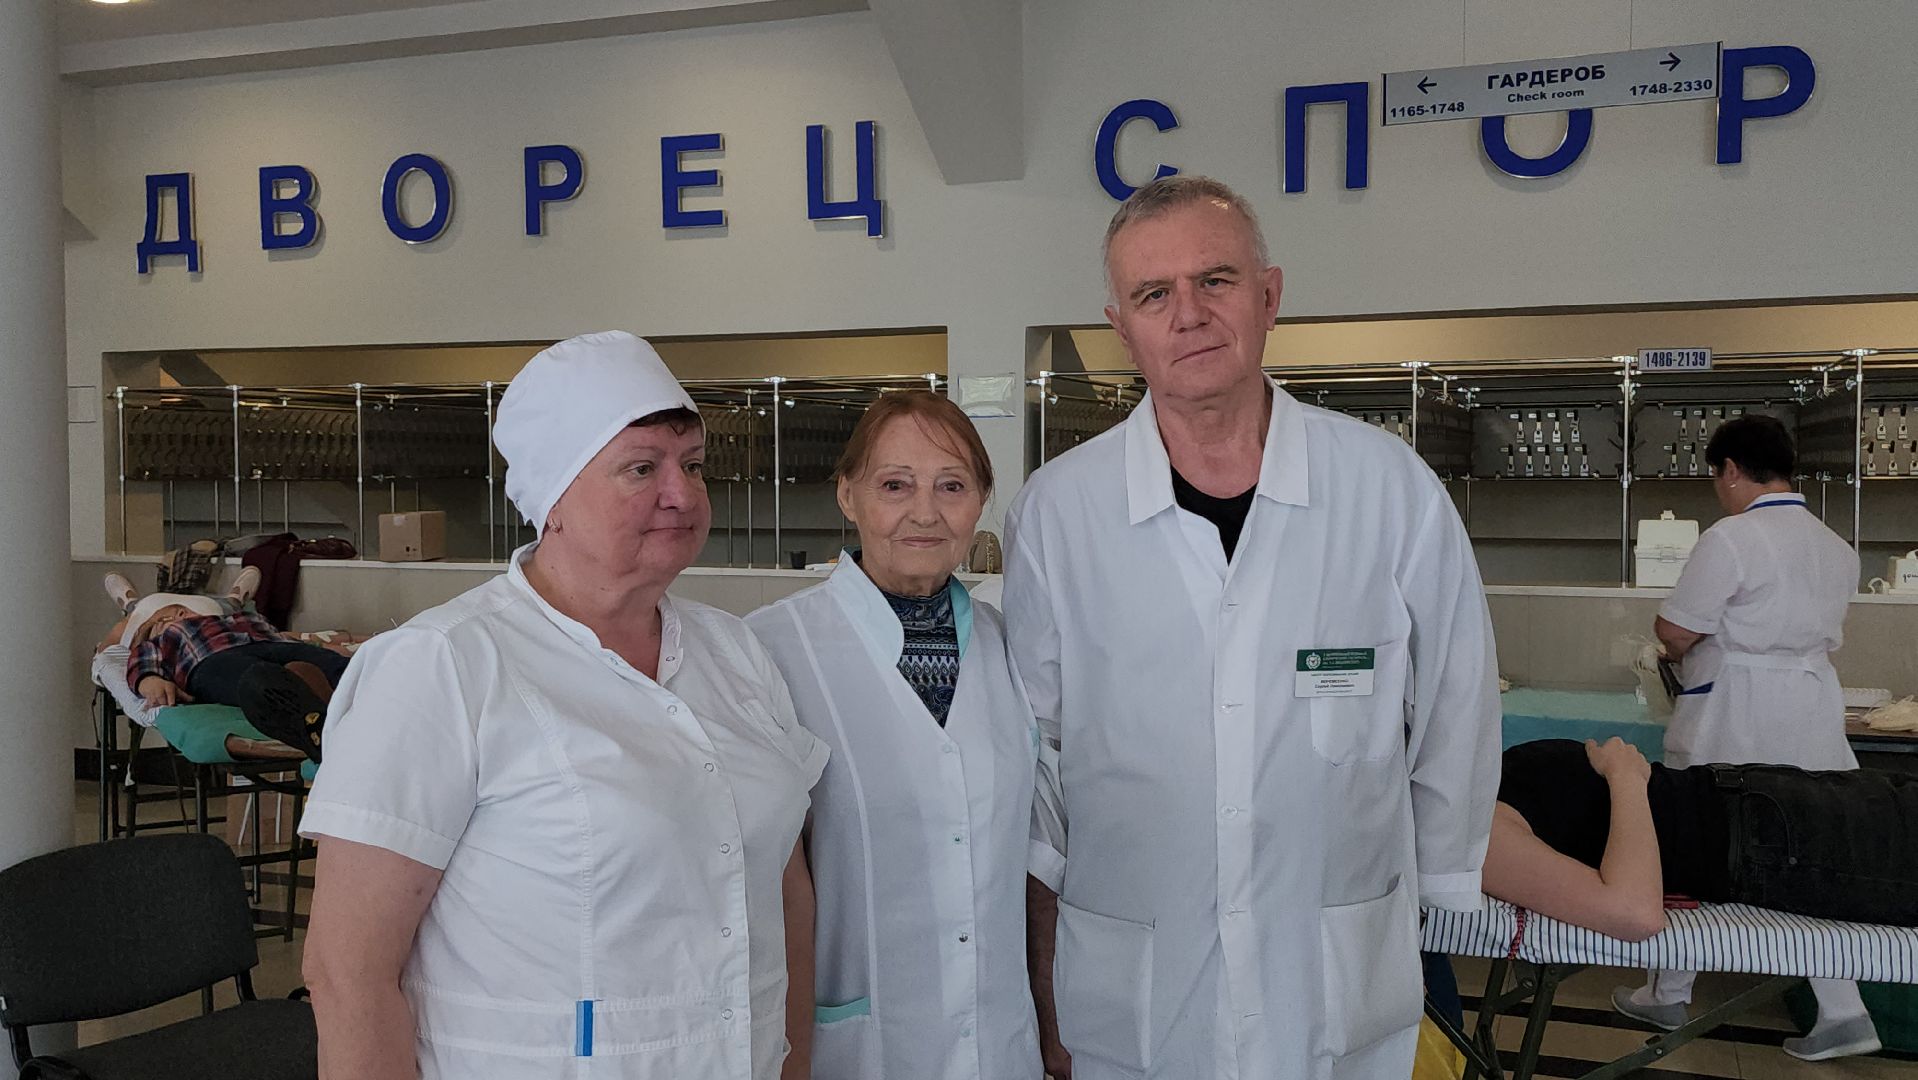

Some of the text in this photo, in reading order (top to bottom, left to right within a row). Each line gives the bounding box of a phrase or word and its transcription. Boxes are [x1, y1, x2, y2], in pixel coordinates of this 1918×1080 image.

[1487, 64, 1606, 90] ГАРДЕРОБ
[1507, 88, 1585, 104] Check room
[1628, 78, 1713, 97] 1748-2330
[1390, 101, 1465, 118] 1165-1748
[136, 120, 884, 274] ДВОРЕЦ
[1645, 351, 1706, 368] 1486-2139
